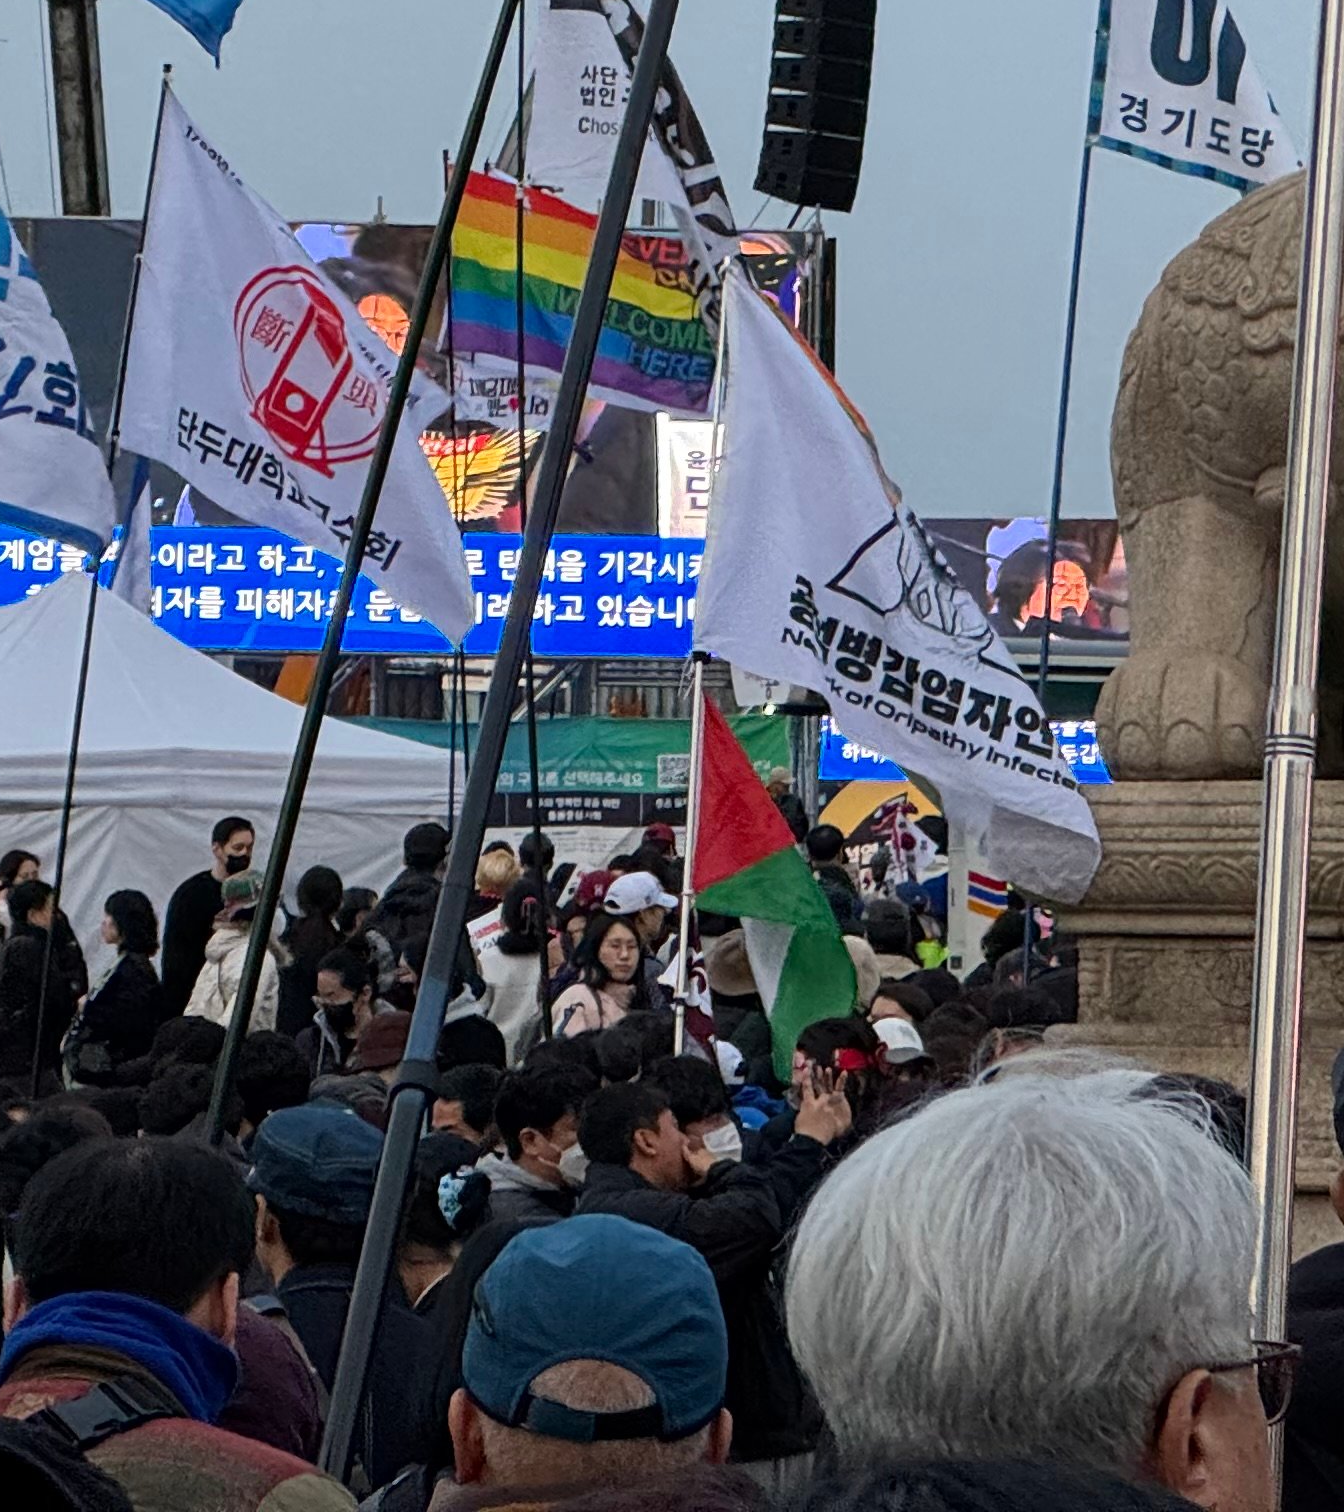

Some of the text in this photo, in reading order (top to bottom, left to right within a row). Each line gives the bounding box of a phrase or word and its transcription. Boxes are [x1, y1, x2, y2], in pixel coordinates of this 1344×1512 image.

[580, 65, 618, 86] 사단
[580, 86, 616, 107] 법인
[578, 116, 621, 137] Chos
[629, 342, 713, 381] HERE
[257, 544, 325, 579] 하고,
[846, 688, 873, 709] of
[986, 745, 1080, 790] Infecte
